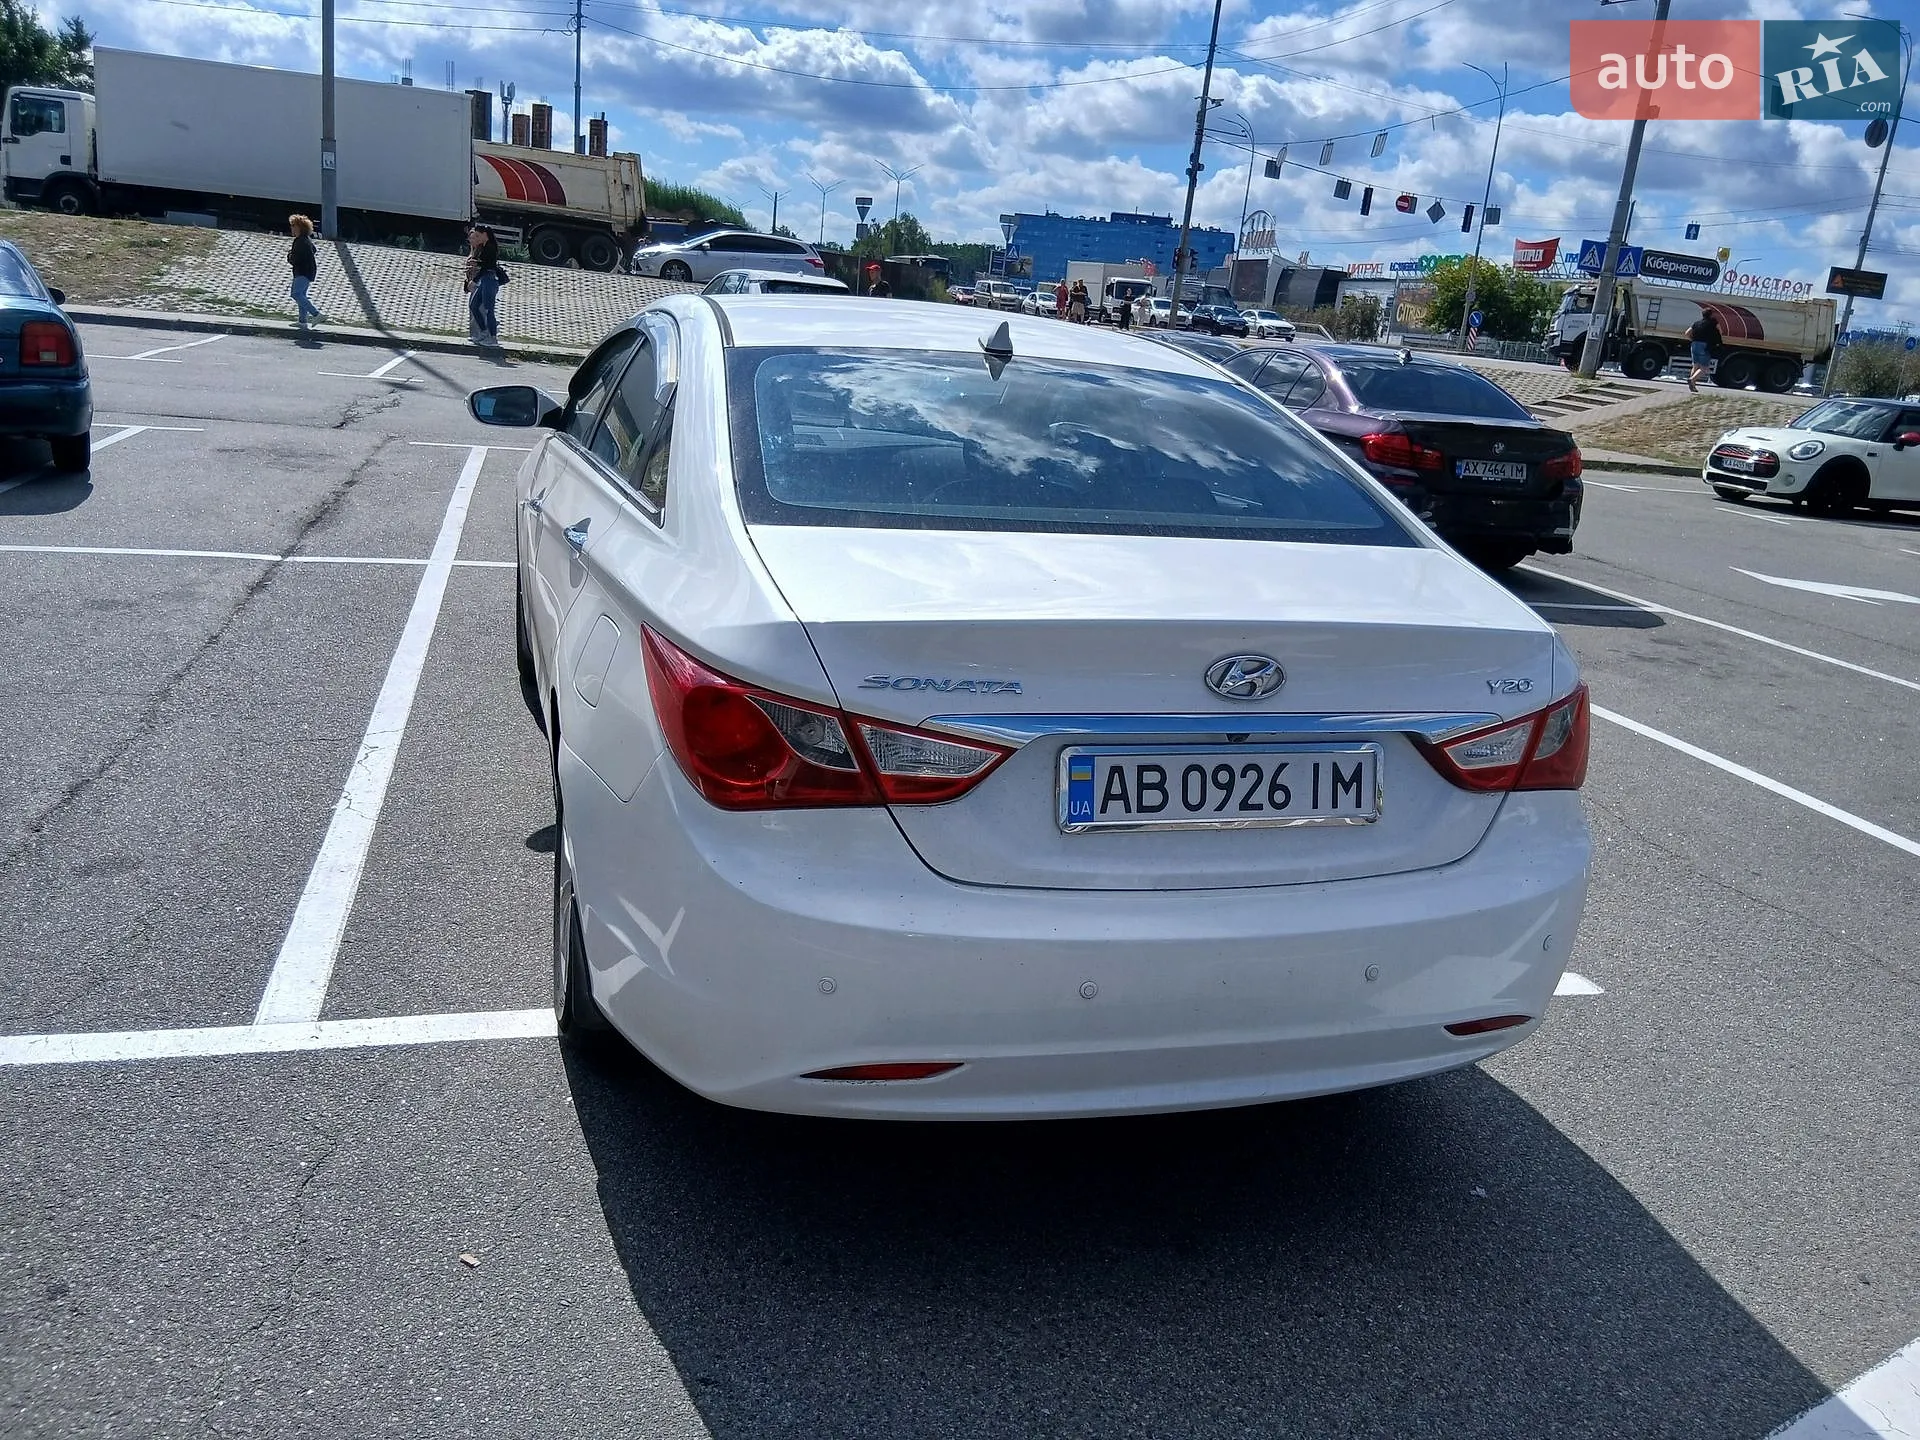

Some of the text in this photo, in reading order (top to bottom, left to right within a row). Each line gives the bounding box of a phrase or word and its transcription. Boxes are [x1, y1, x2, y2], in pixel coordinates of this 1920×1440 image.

[1645, 255, 1713, 276] Кібернетики
[1724, 269, 1813, 294] ФОКСТРОТ
[1463, 461, 1479, 474] AX
[1482, 463, 1506, 476] 7464
[1511, 465, 1524, 478] IM
[857, 674, 1023, 695] SONATA
[1486, 678, 1534, 694] Y20
[1100, 761, 1363, 814] AB 0926 IM
[1070, 800, 1091, 815] UA
